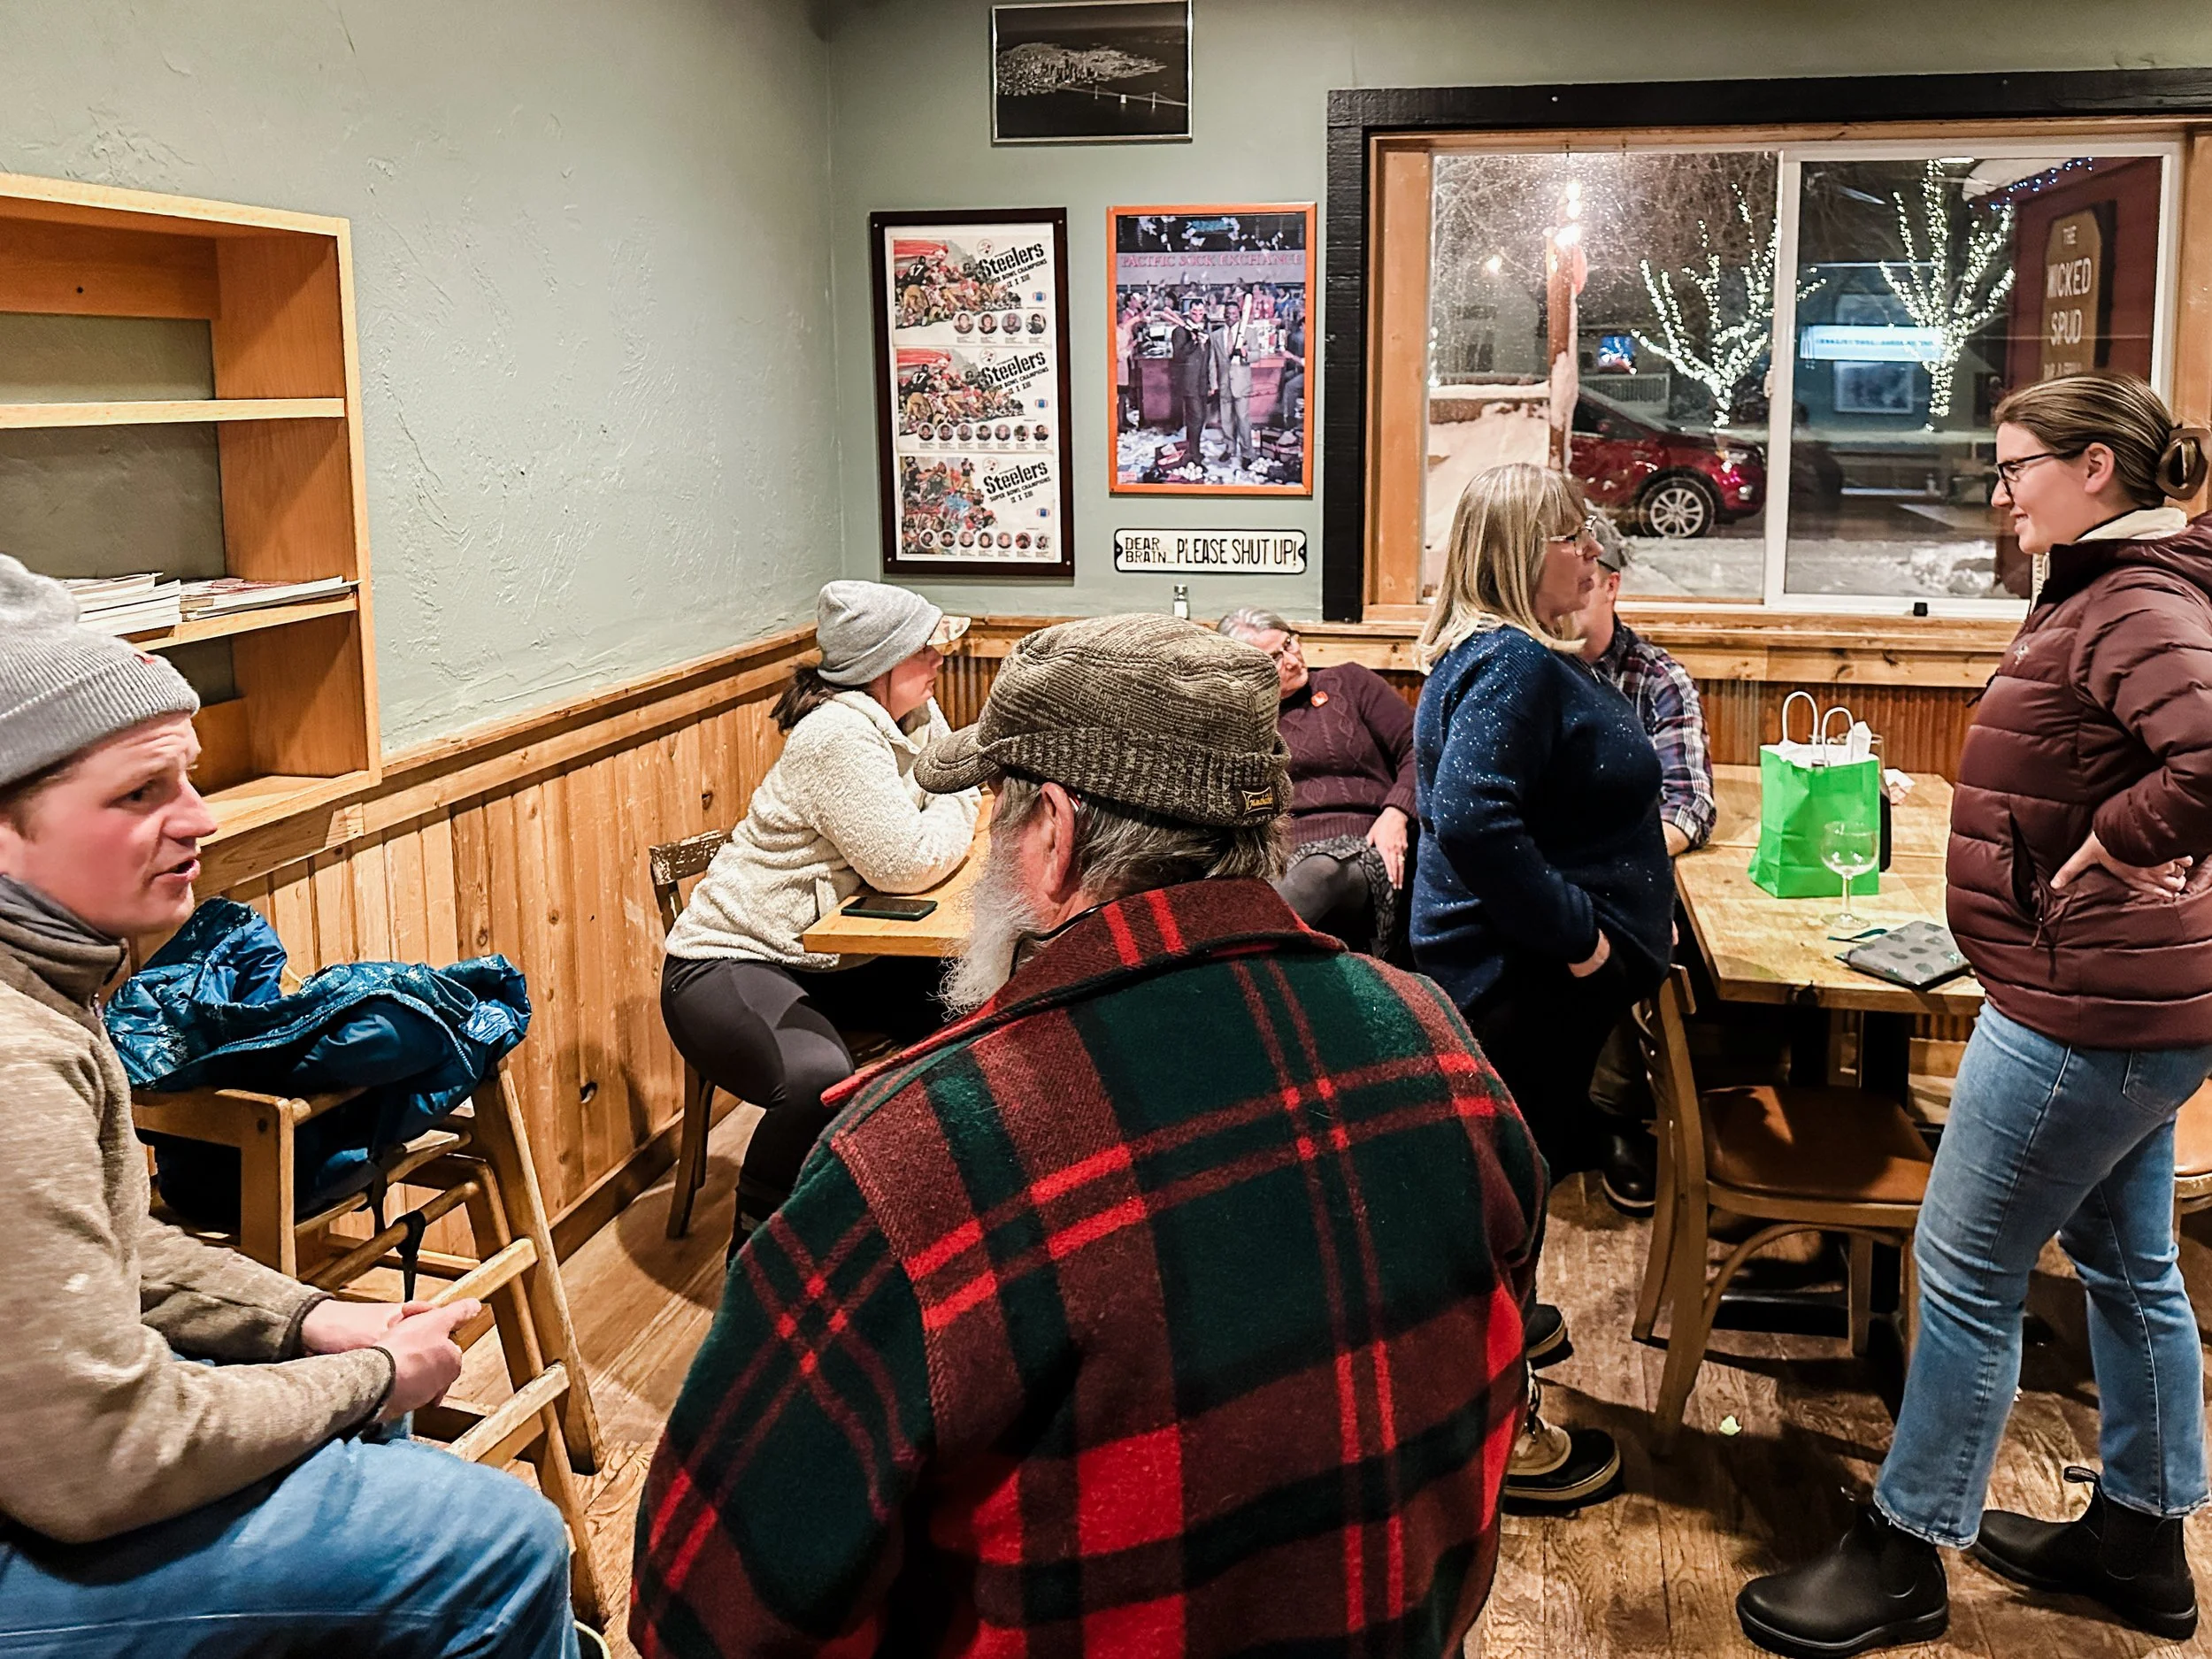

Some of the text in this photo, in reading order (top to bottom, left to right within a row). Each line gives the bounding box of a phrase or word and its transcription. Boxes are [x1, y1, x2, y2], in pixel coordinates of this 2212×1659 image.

[978, 243, 1044, 277] Steelers
[1121, 254, 1176, 267] PACIFIC
[1002, 271, 1018, 280] BOWL
[2050, 309, 2082, 346] SPUD
[981, 351, 1046, 384] Steelers
[1004, 378, 1018, 388] BOWL
[983, 462, 1048, 494] Steelers
[989, 492, 1005, 503] SUPER
[1006, 488, 1021, 496] BOWL
[1125, 537, 1160, 550] DEAR
[1177, 538, 1297, 566] PLEASE SHUT UP!
